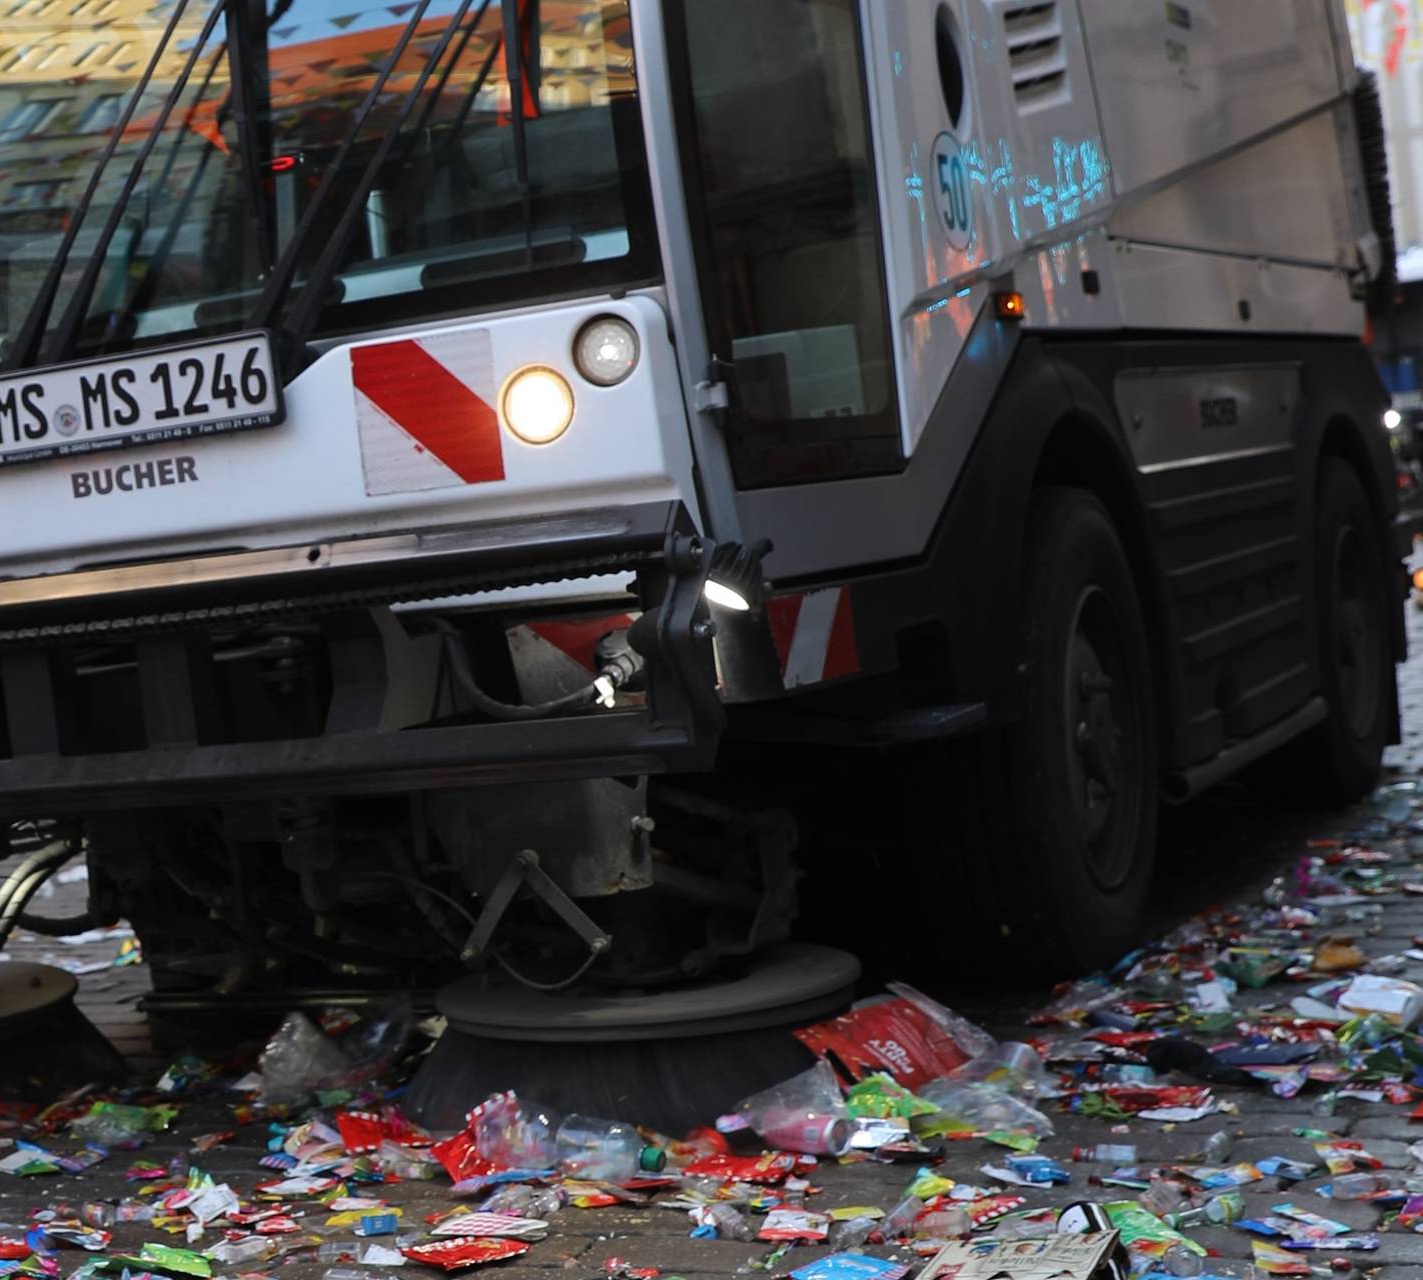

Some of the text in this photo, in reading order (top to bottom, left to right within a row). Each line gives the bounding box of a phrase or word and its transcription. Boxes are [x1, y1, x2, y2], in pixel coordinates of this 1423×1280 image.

[936, 153, 968, 232] 50
[79, 367, 140, 431] MS
[149, 346, 268, 421] 1246
[70, 455, 200, 499] BUCHER
